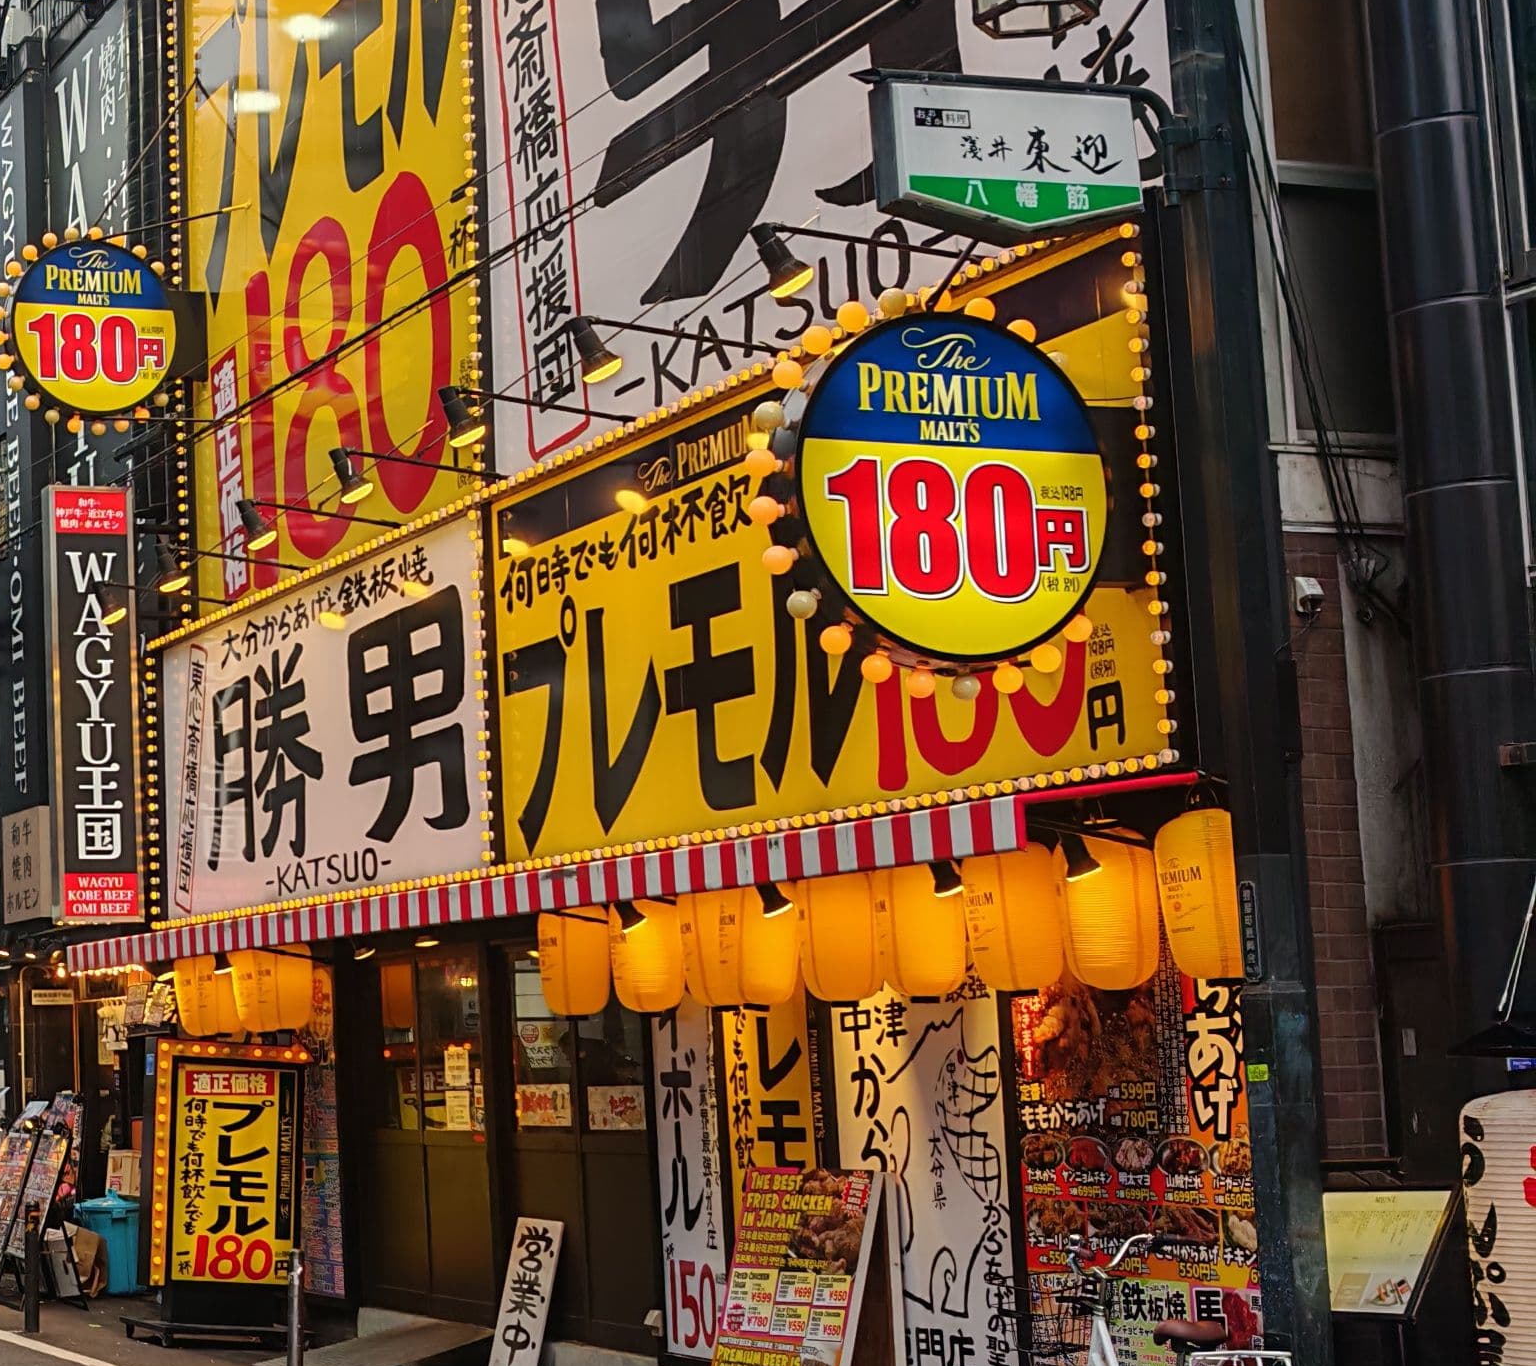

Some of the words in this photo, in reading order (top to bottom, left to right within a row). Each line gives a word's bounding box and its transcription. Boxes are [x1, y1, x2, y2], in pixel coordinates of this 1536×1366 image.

[944, 111, 969, 127] 料理
[965, 180, 1089, 210] 八幡筋
[68, 246, 116, 269] The
[45, 264, 143, 296] PREMIUM
[77, 292, 110, 306] MALT'S
[26, 311, 167, 386] 180円
[902, 327, 991, 371] The
[857, 362, 1041, 421] PREMIUM
[919, 418, 981, 444] MALT'S
[825, 455, 1090, 603] 180円
[65, 551, 124, 861] WAGYU王国
[1087, 680, 1126, 752] 円
[11, 677, 28, 796] BEEF
[208, 584, 470, 872] 勝男
[68, 890, 102, 901] KOBE
[104, 890, 134, 901] BEEF
[78, 877, 123, 888] WAGYU
[6, 886, 41, 915] ホルモン
[72, 903, 97, 914] OMI
[100, 903, 131, 914] BEEF
[840, 997, 907, 1051] 中津
[193, 1073, 268, 1095] 適正価格
[945, 1060, 960, 1108] 中津
[1019, 1083, 1046, 1102] 定番!
[1121, 1083, 1157, 1106] 599円
[1021, 1100, 1106, 1130] ももからあげ
[1123, 1110, 1159, 1133] 780円
[180, 1097, 209, 1236] 何時でも何杯飲んでも
[206, 1099, 275, 1236] プレモル
[279, 1152, 292, 1201] PREMIUM
[927, 1133, 947, 1210] 大分県
[1118, 1173, 1151, 1186] 明太マヨ
[751, 1173, 771, 1191] THE
[774, 1174, 803, 1192] BEST
[746, 1193, 779, 1209] FRIED
[781, 1194, 834, 1211] CHICKEN
[742, 1212, 755, 1227] IN
[756, 1212, 801, 1230] JAPAN!
[192, 1234, 274, 1281] 180
[1179, 1262, 1211, 1280] 550円
[1223, 1248, 1258, 1267] チキン
[502, 1226, 554, 1366] 営業中
[669, 1258, 716, 1349] 150
[1121, 1281, 1188, 1323] 鉄板焼
[716, 1346, 761, 1366] PREMIUM
